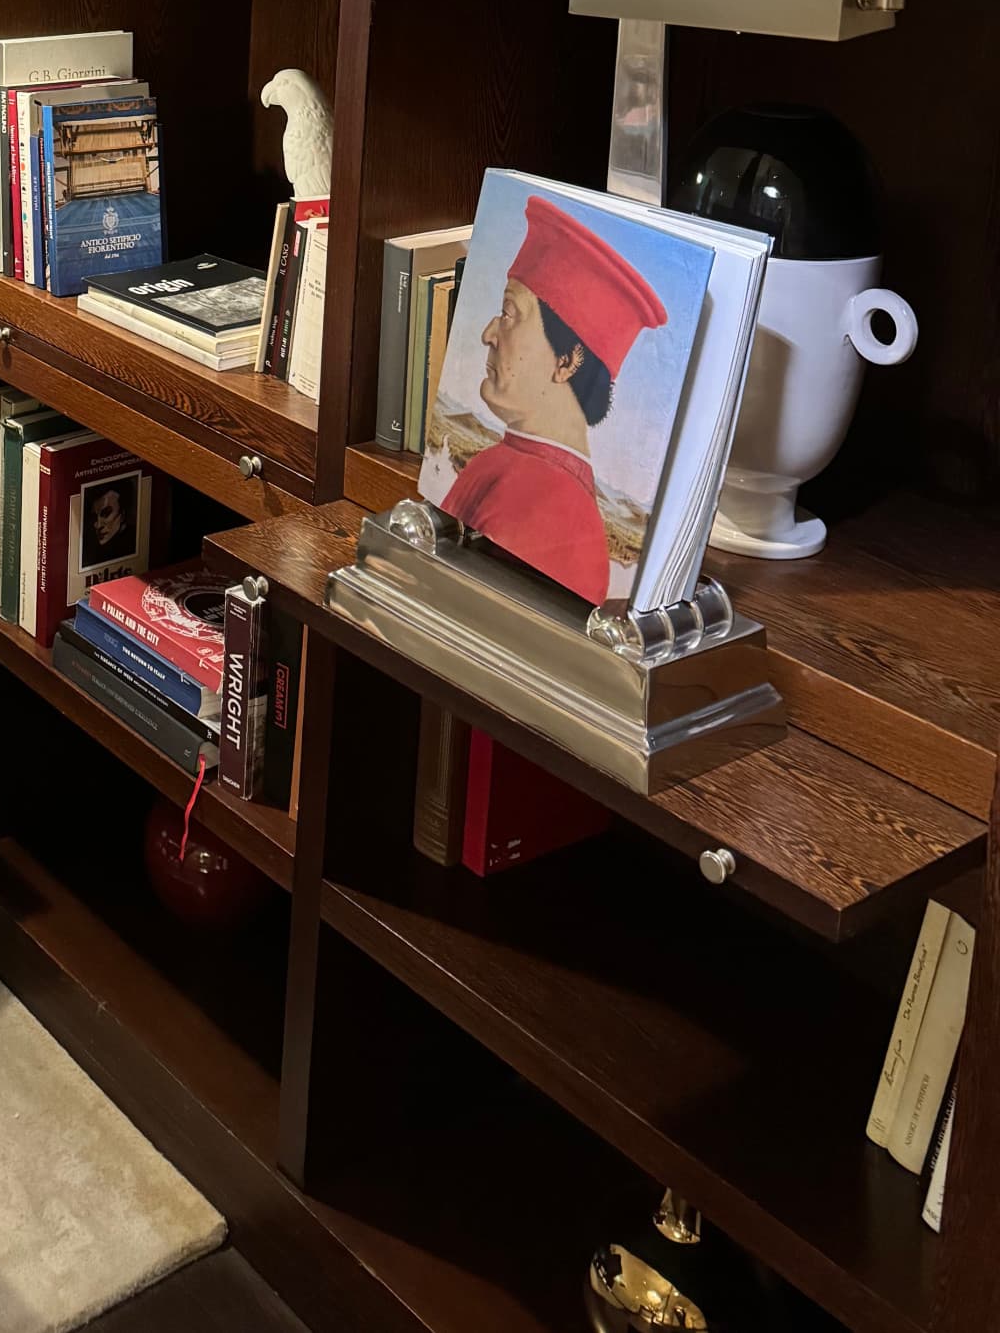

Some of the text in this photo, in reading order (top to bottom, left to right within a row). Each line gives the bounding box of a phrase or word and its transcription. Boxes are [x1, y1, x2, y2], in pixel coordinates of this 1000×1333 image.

[29, 66, 106, 83] G.B. Giorgini
[80, 233, 141, 248] ANTICO SETIFICIO
[88, 242, 135, 254] FIORENTINO
[280, 243, 290, 266] CASO
[128, 279, 195, 295] origin
[74, 466, 99, 478] ARTISTI
[107, 603, 125, 623] PALACE
[125, 616, 136, 630] AND
[137, 623, 147, 638] THE
[146, 629, 160, 647] CITY
[131, 652, 147, 667] RETURN
[147, 663, 153, 671] TO
[275, 668, 286, 709] CREAM
[226, 652, 244, 750] WRIGHT
